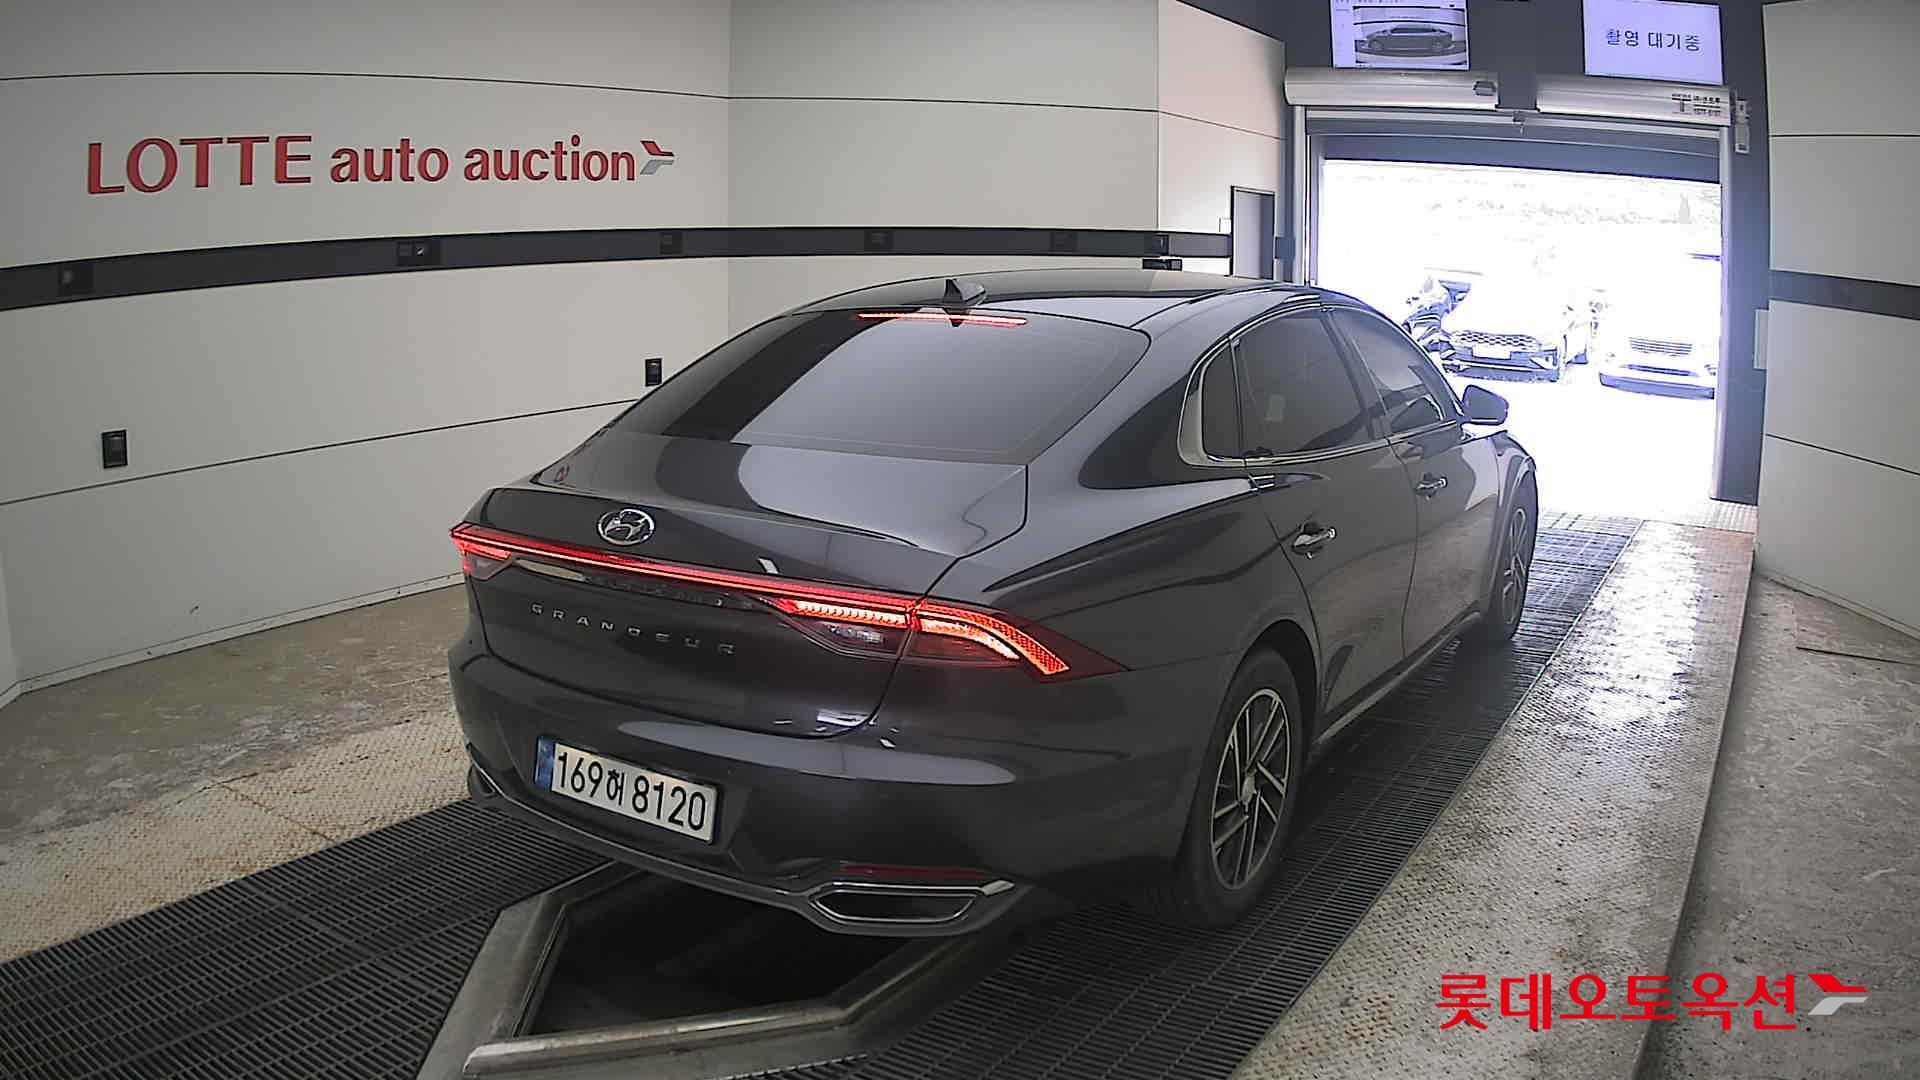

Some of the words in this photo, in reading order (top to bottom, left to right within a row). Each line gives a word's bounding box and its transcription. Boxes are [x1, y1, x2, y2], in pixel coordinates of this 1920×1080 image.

[1648, 32, 1700, 51] 대기중
[86, 135, 312, 195] LOTTE
[330, 138, 449, 183] auto
[464, 134, 636, 182] auction
[531, 603, 736, 655] GRANDEUR
[557, 751, 625, 806] 169허
[631, 774, 706, 831] 8120
